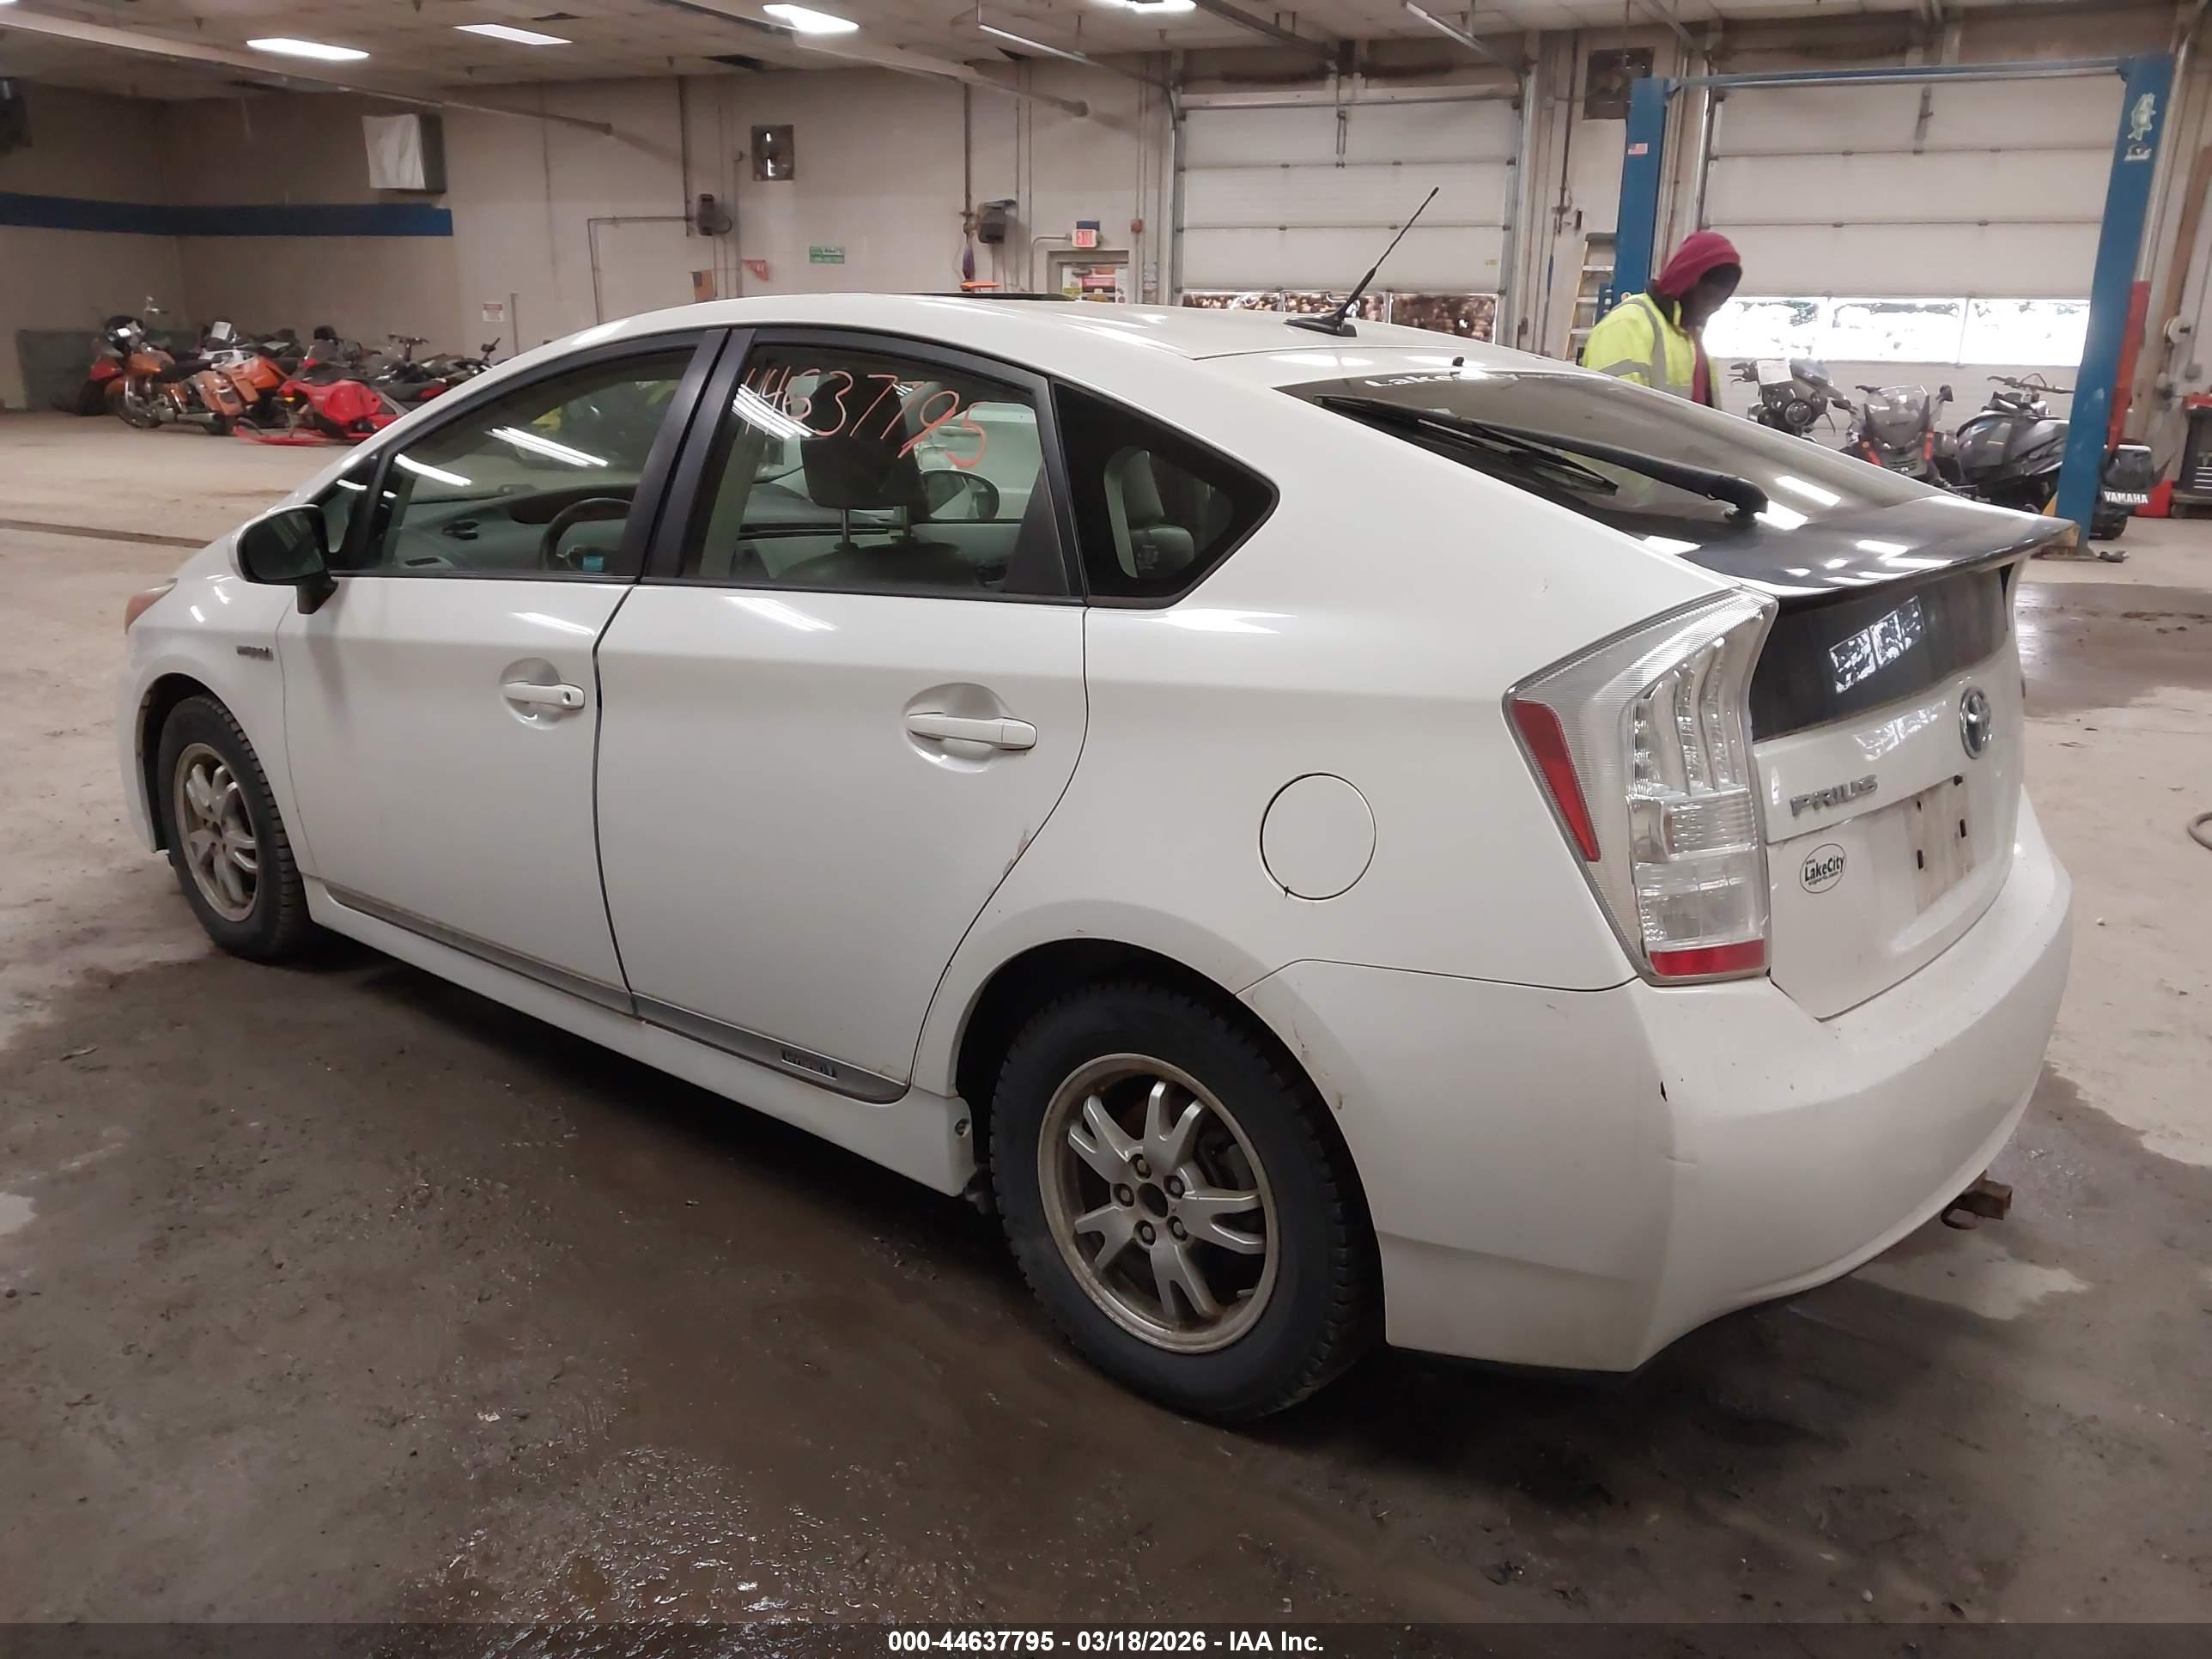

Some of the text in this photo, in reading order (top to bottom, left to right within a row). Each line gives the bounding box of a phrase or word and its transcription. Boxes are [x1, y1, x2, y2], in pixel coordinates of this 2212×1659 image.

[2104, 490, 2149, 504] YAMAHA
[1789, 775, 1879, 817] PRIUS
[1804, 855, 1845, 882] LakeCity
